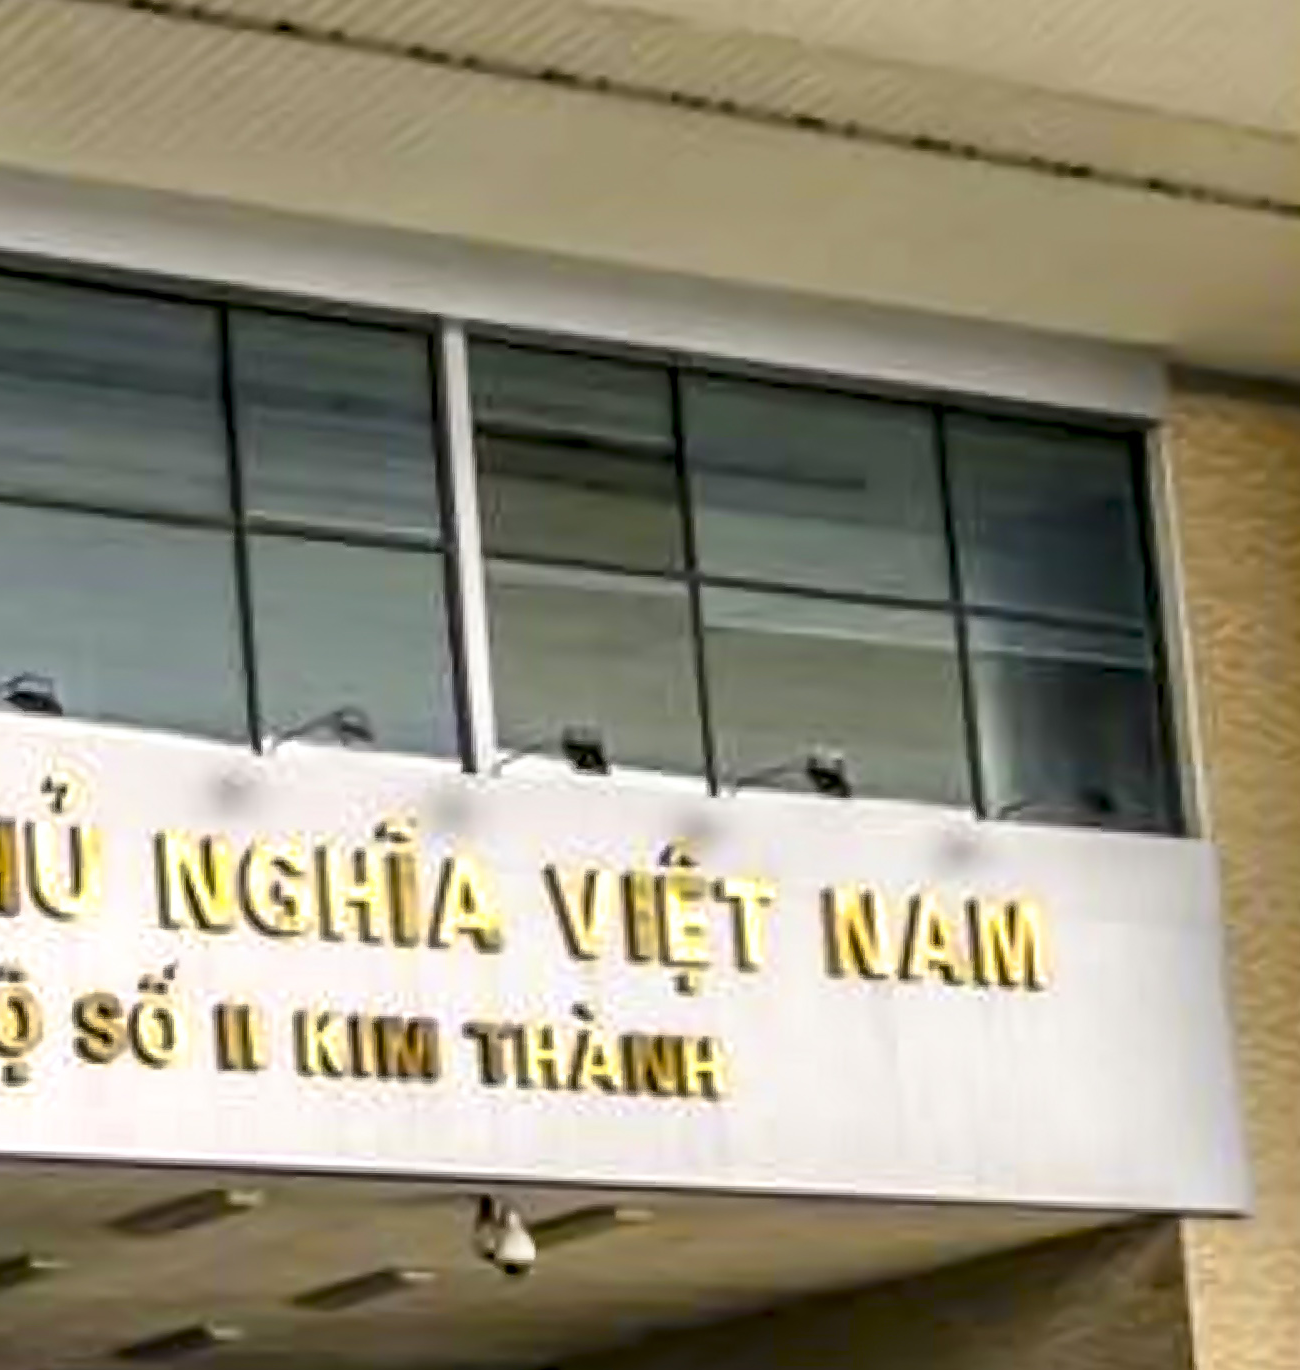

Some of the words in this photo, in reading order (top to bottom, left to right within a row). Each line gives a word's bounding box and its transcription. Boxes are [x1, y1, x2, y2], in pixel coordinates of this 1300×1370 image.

[154, 809, 503, 952] NGHĨA
[543, 842, 777, 995] VIỆT
[821, 884, 1053, 991] NAM
[73, 962, 177, 1067] SỐ
[214, 1002, 261, 1072] II
[293, 1009, 441, 1084] KIM
[464, 1003, 731, 1101] THÀNH
